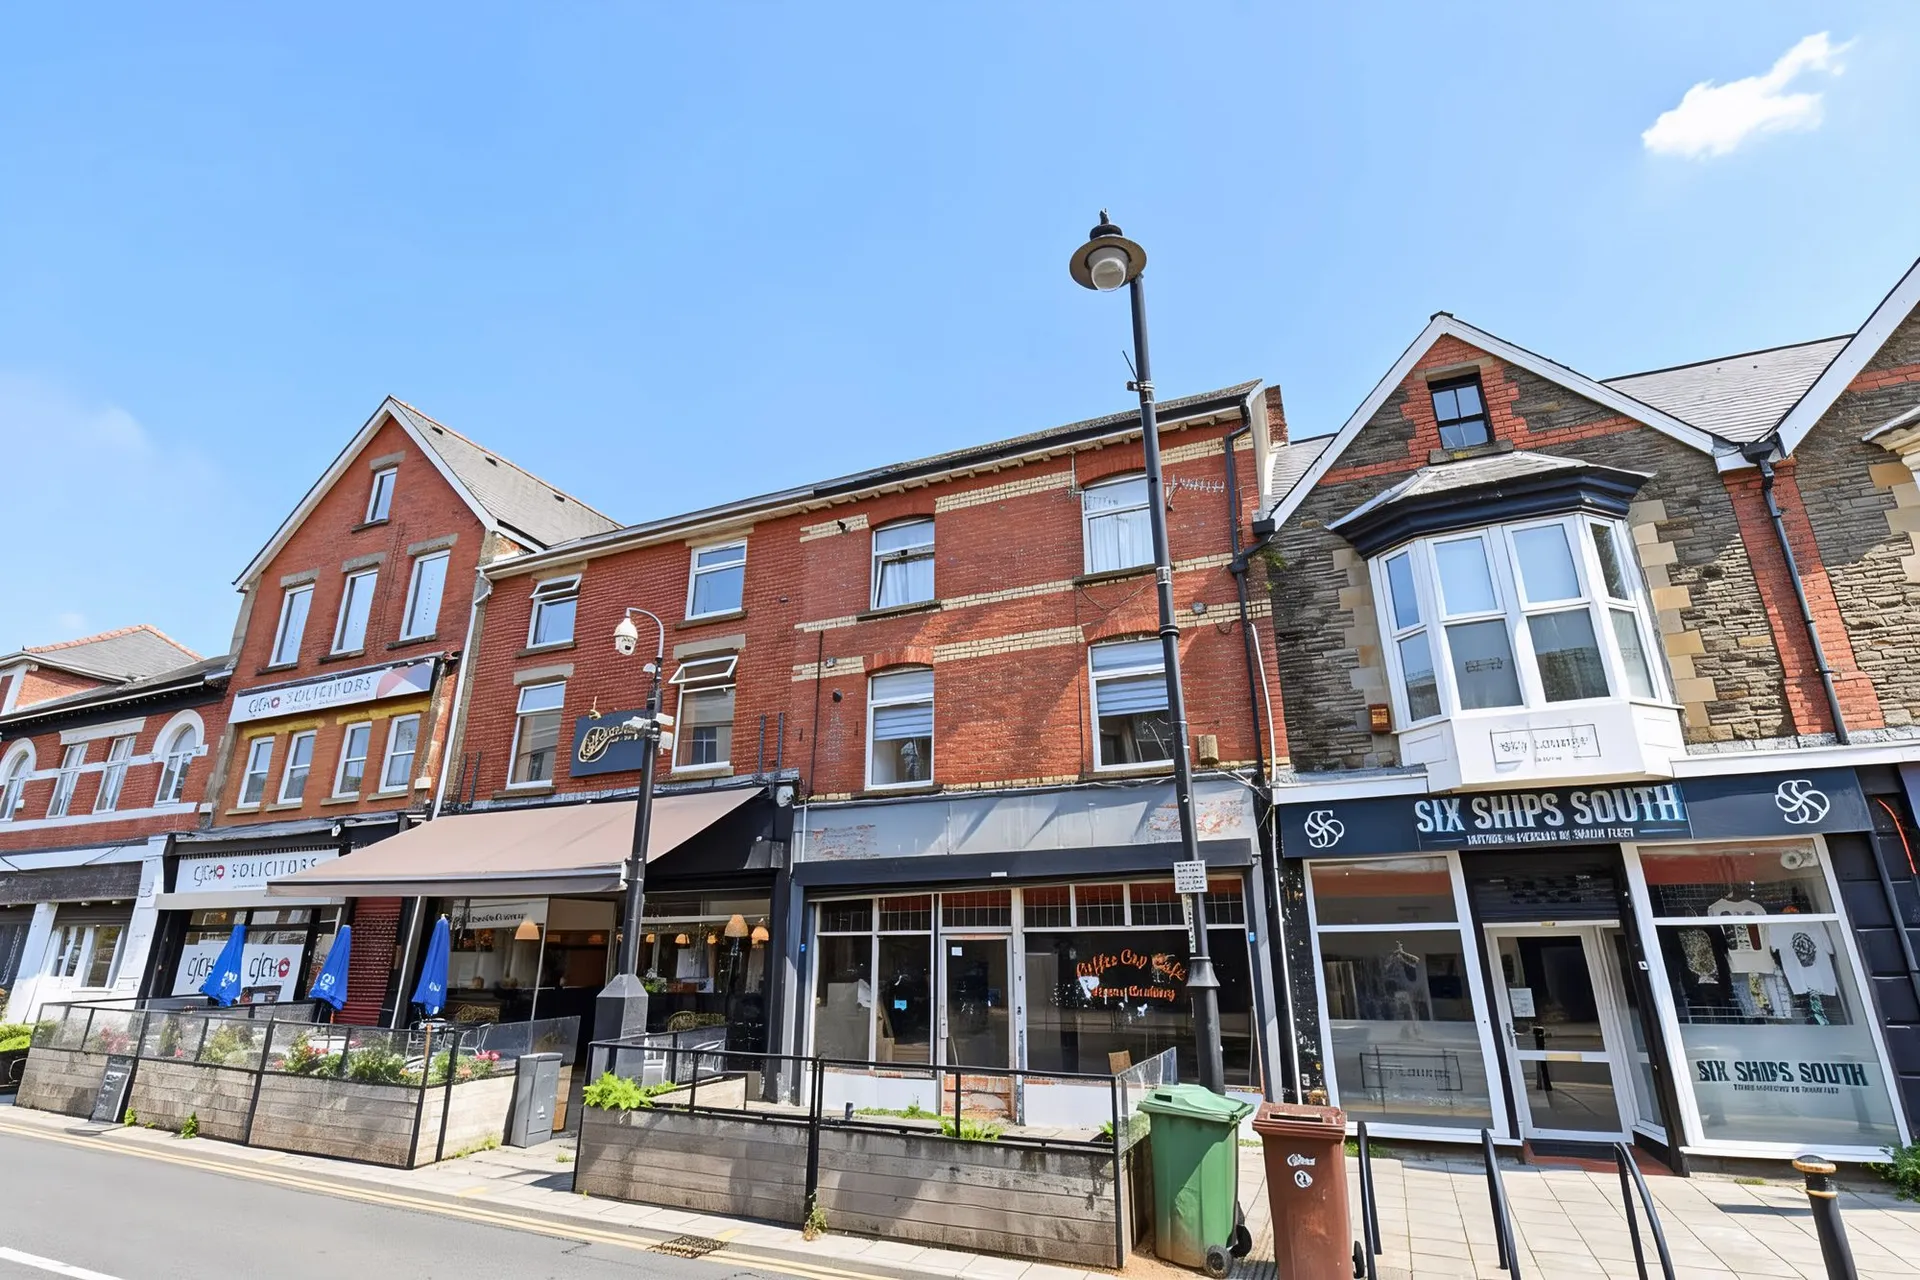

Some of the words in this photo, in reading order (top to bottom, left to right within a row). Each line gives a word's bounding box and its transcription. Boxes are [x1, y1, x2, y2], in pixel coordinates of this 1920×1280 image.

[285, 677, 371, 705] SOLICITORS
[1415, 798, 1465, 833] SIX
[1471, 792, 1565, 830] SHIPS
[1570, 784, 1686, 825] SOUTH
[1696, 1060, 1731, 1082] SIX
[1734, 1061, 1795, 1082] SHIPS
[1799, 1062, 1869, 1086] SOUTH
